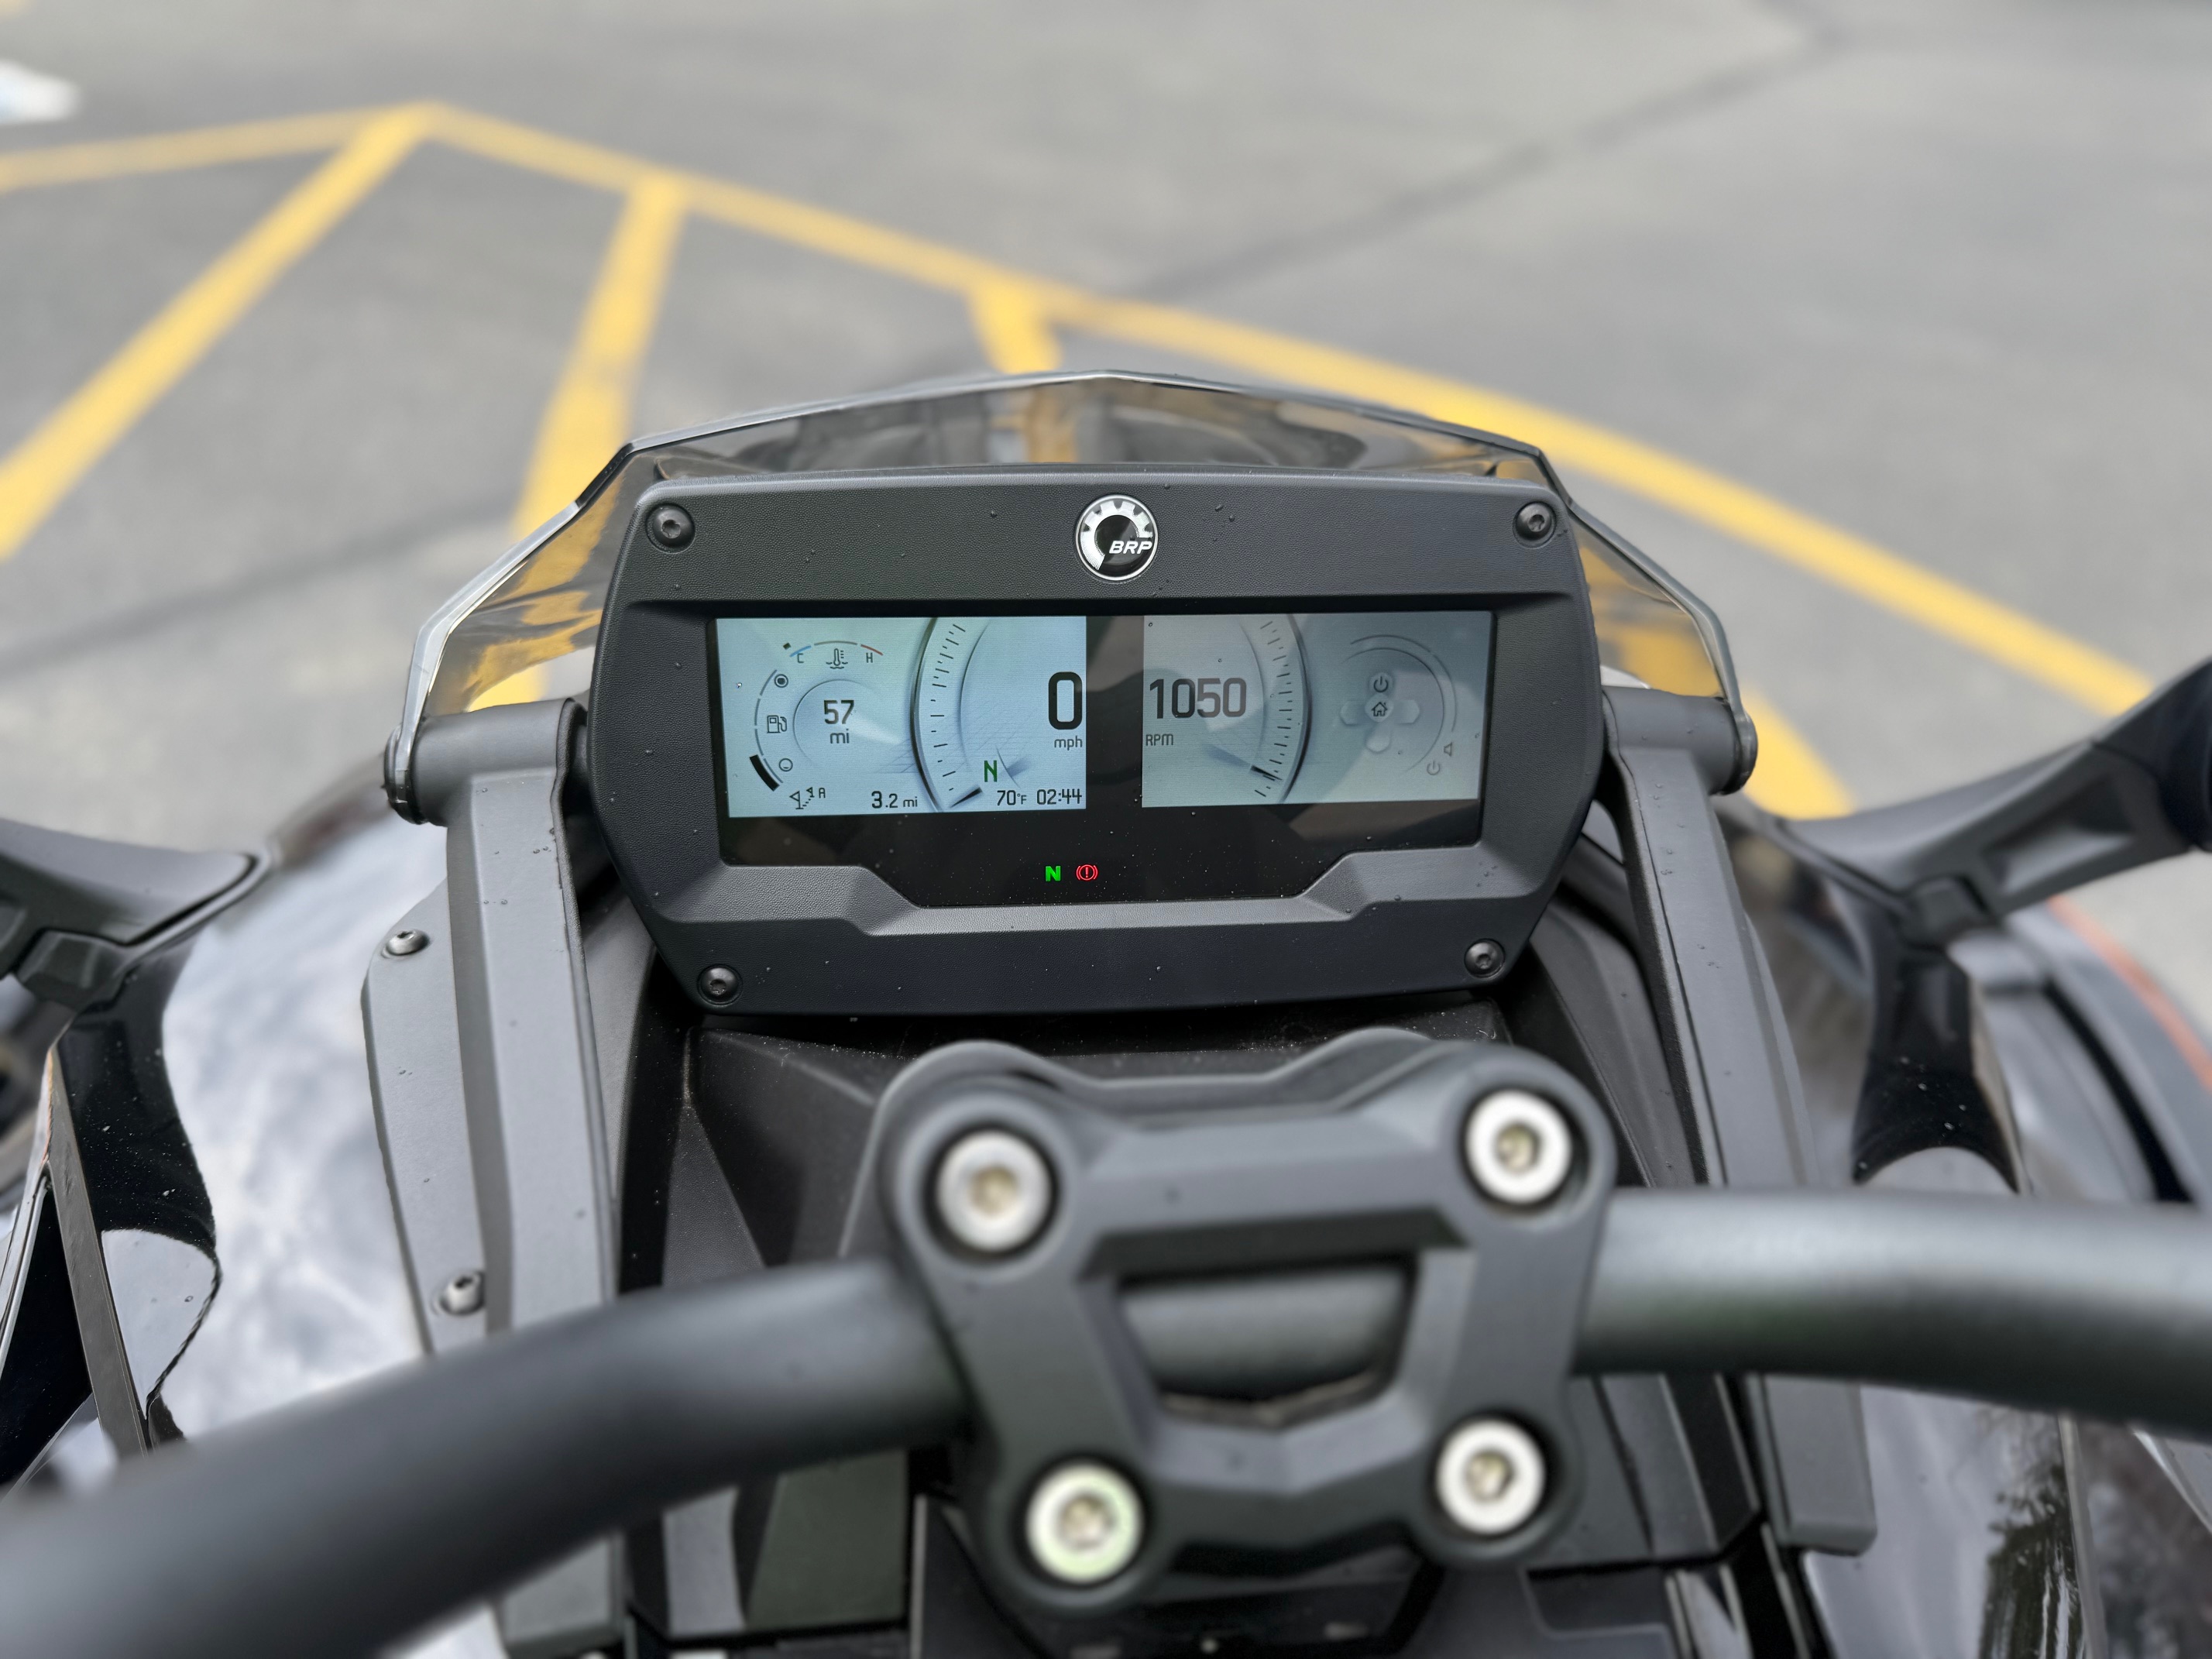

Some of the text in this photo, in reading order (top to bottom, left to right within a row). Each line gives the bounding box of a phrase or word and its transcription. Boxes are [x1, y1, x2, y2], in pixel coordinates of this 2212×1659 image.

[1108, 540, 1152, 555] BRP
[796, 652, 805, 664] C
[865, 651, 874, 664] H
[1048, 672, 1083, 730] 0
[1149, 677, 1247, 719] 1050
[823, 699, 855, 725] 57
[830, 728, 850, 744] mi
[1053, 736, 1083, 751] mph
[1146, 733, 1174, 747] RPM
[984, 760, 998, 783] N
[818, 787, 826, 799] A
[871, 790, 918, 809] 3.2 mi
[1036, 788, 1083, 805] 02:44
[1045, 865, 1061, 881] N
